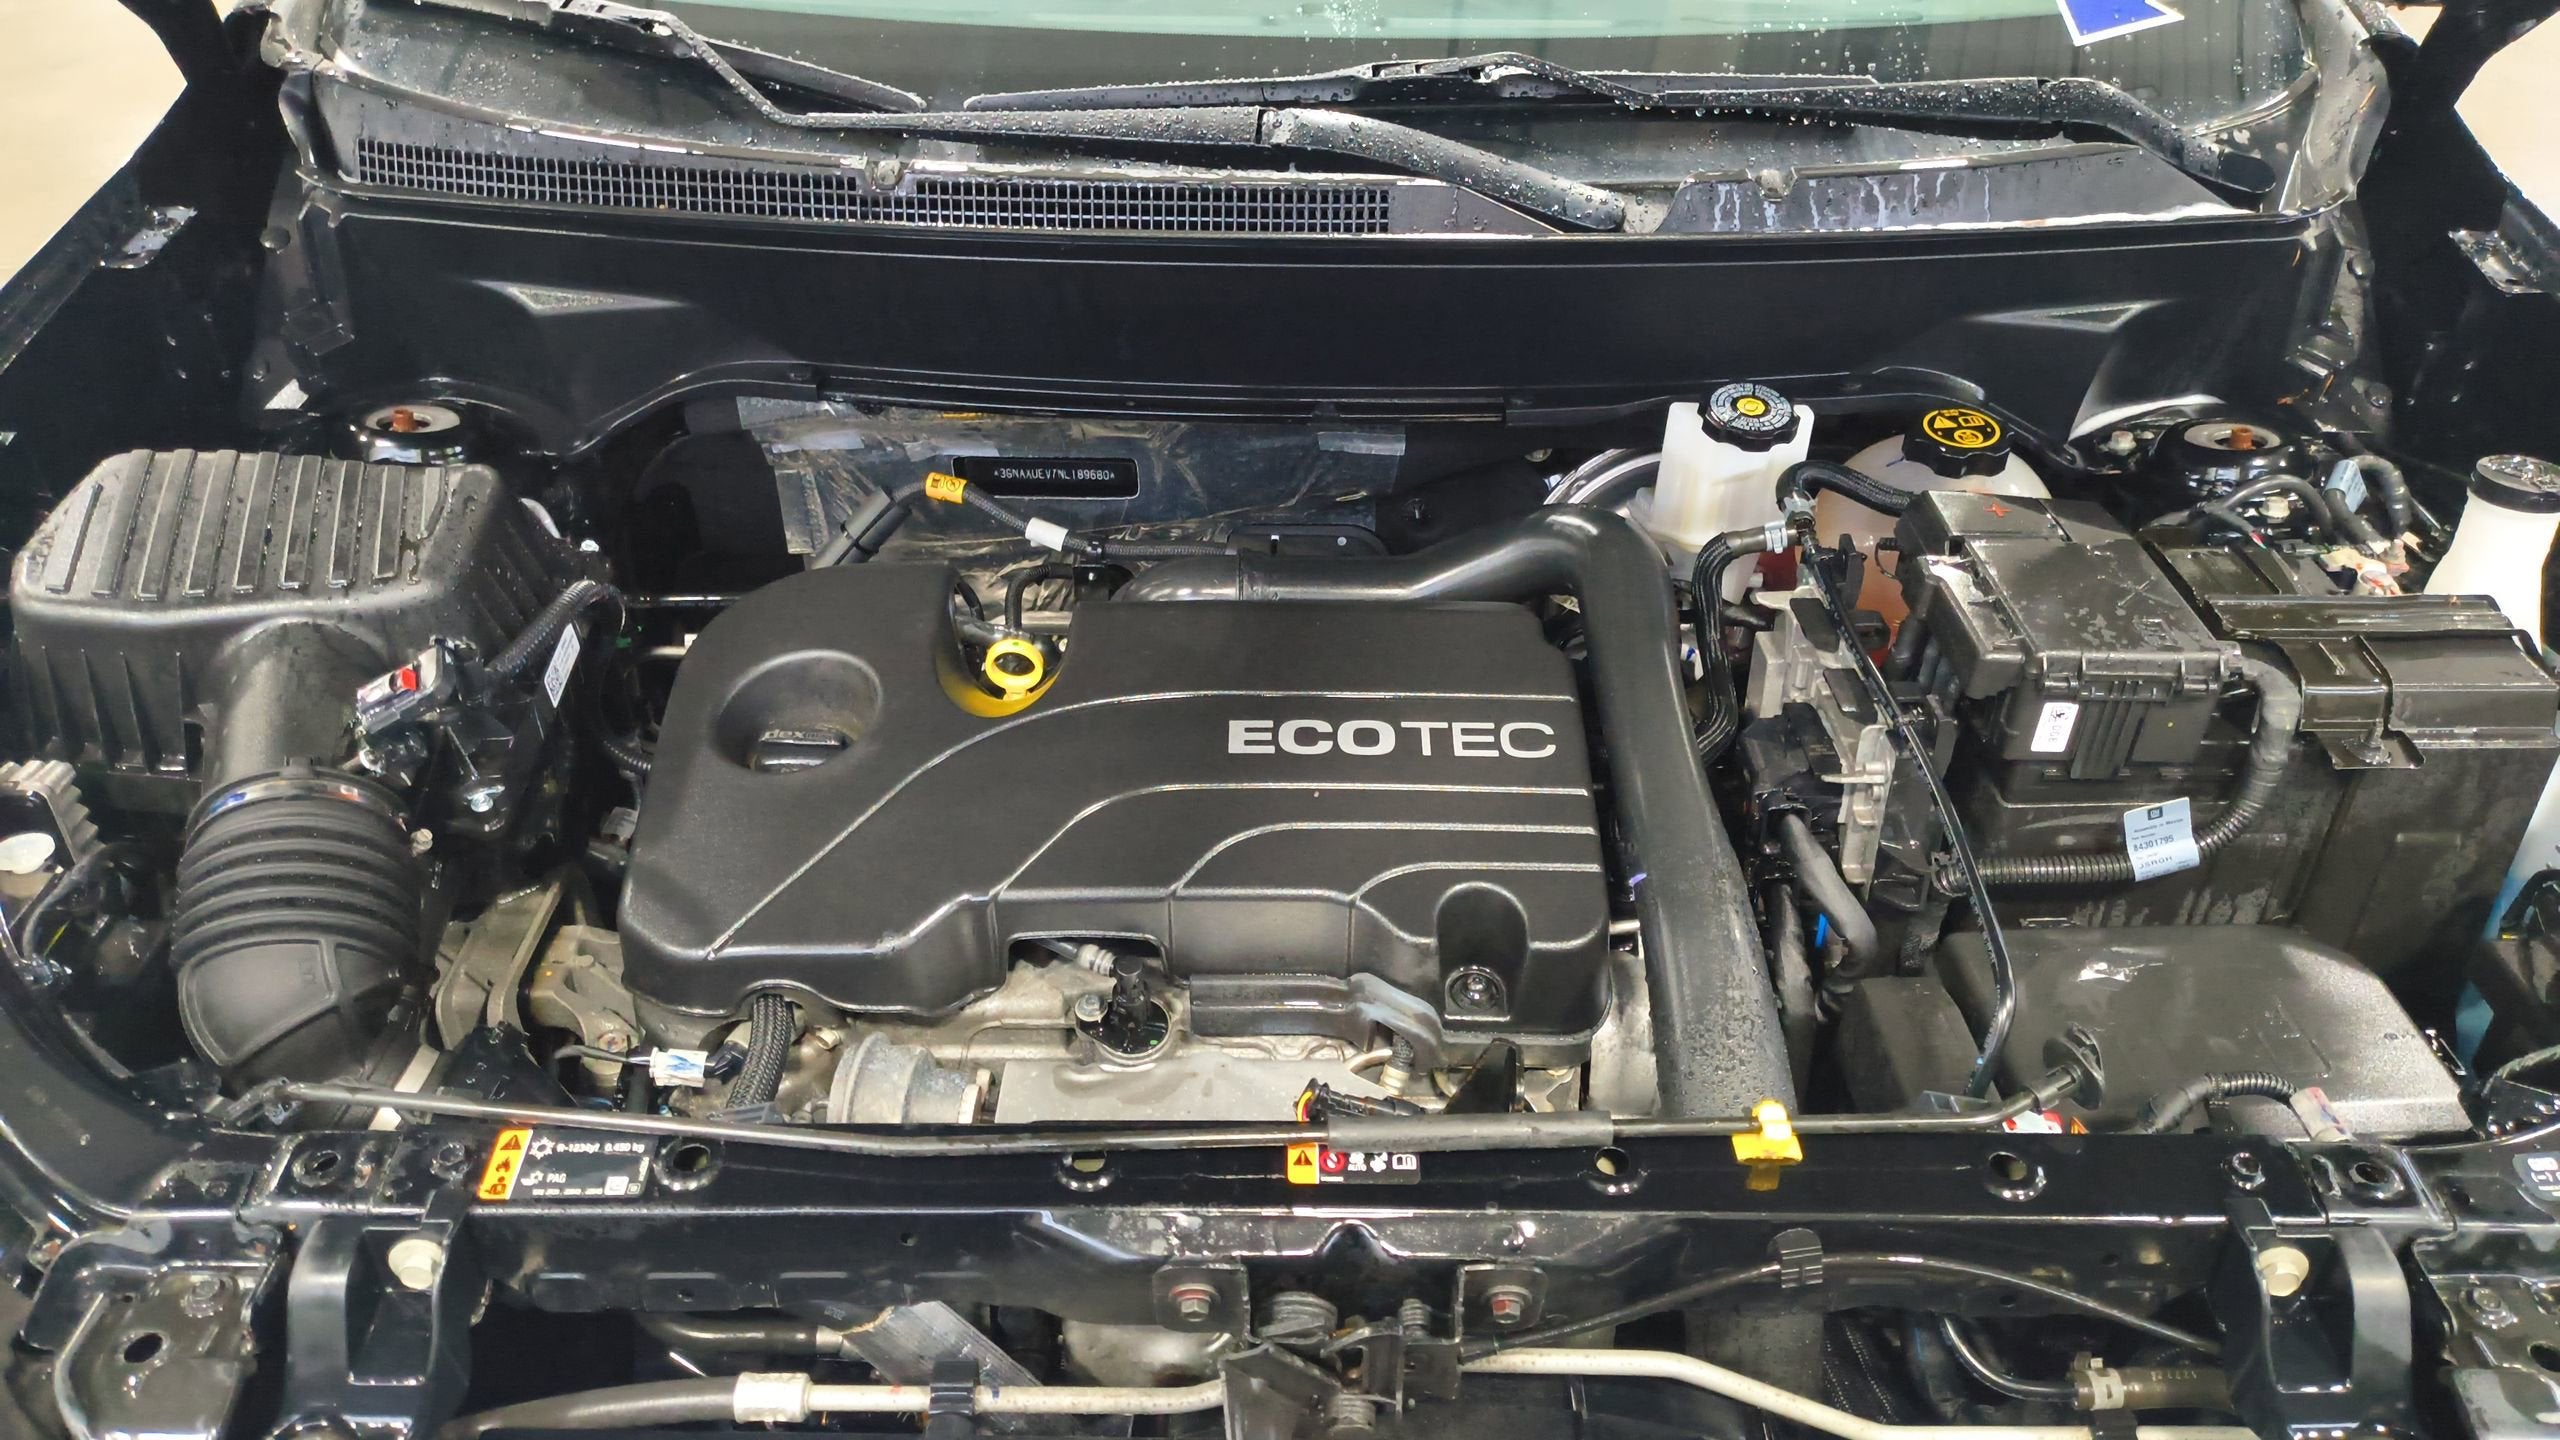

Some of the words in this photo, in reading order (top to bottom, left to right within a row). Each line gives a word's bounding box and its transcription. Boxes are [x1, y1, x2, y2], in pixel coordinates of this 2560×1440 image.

[1228, 719, 1557, 759] ECOTEC
[2133, 835, 2174, 851] 84301795
[632, 1142, 646, 1154] kg
[546, 1172, 567, 1184] PAG
